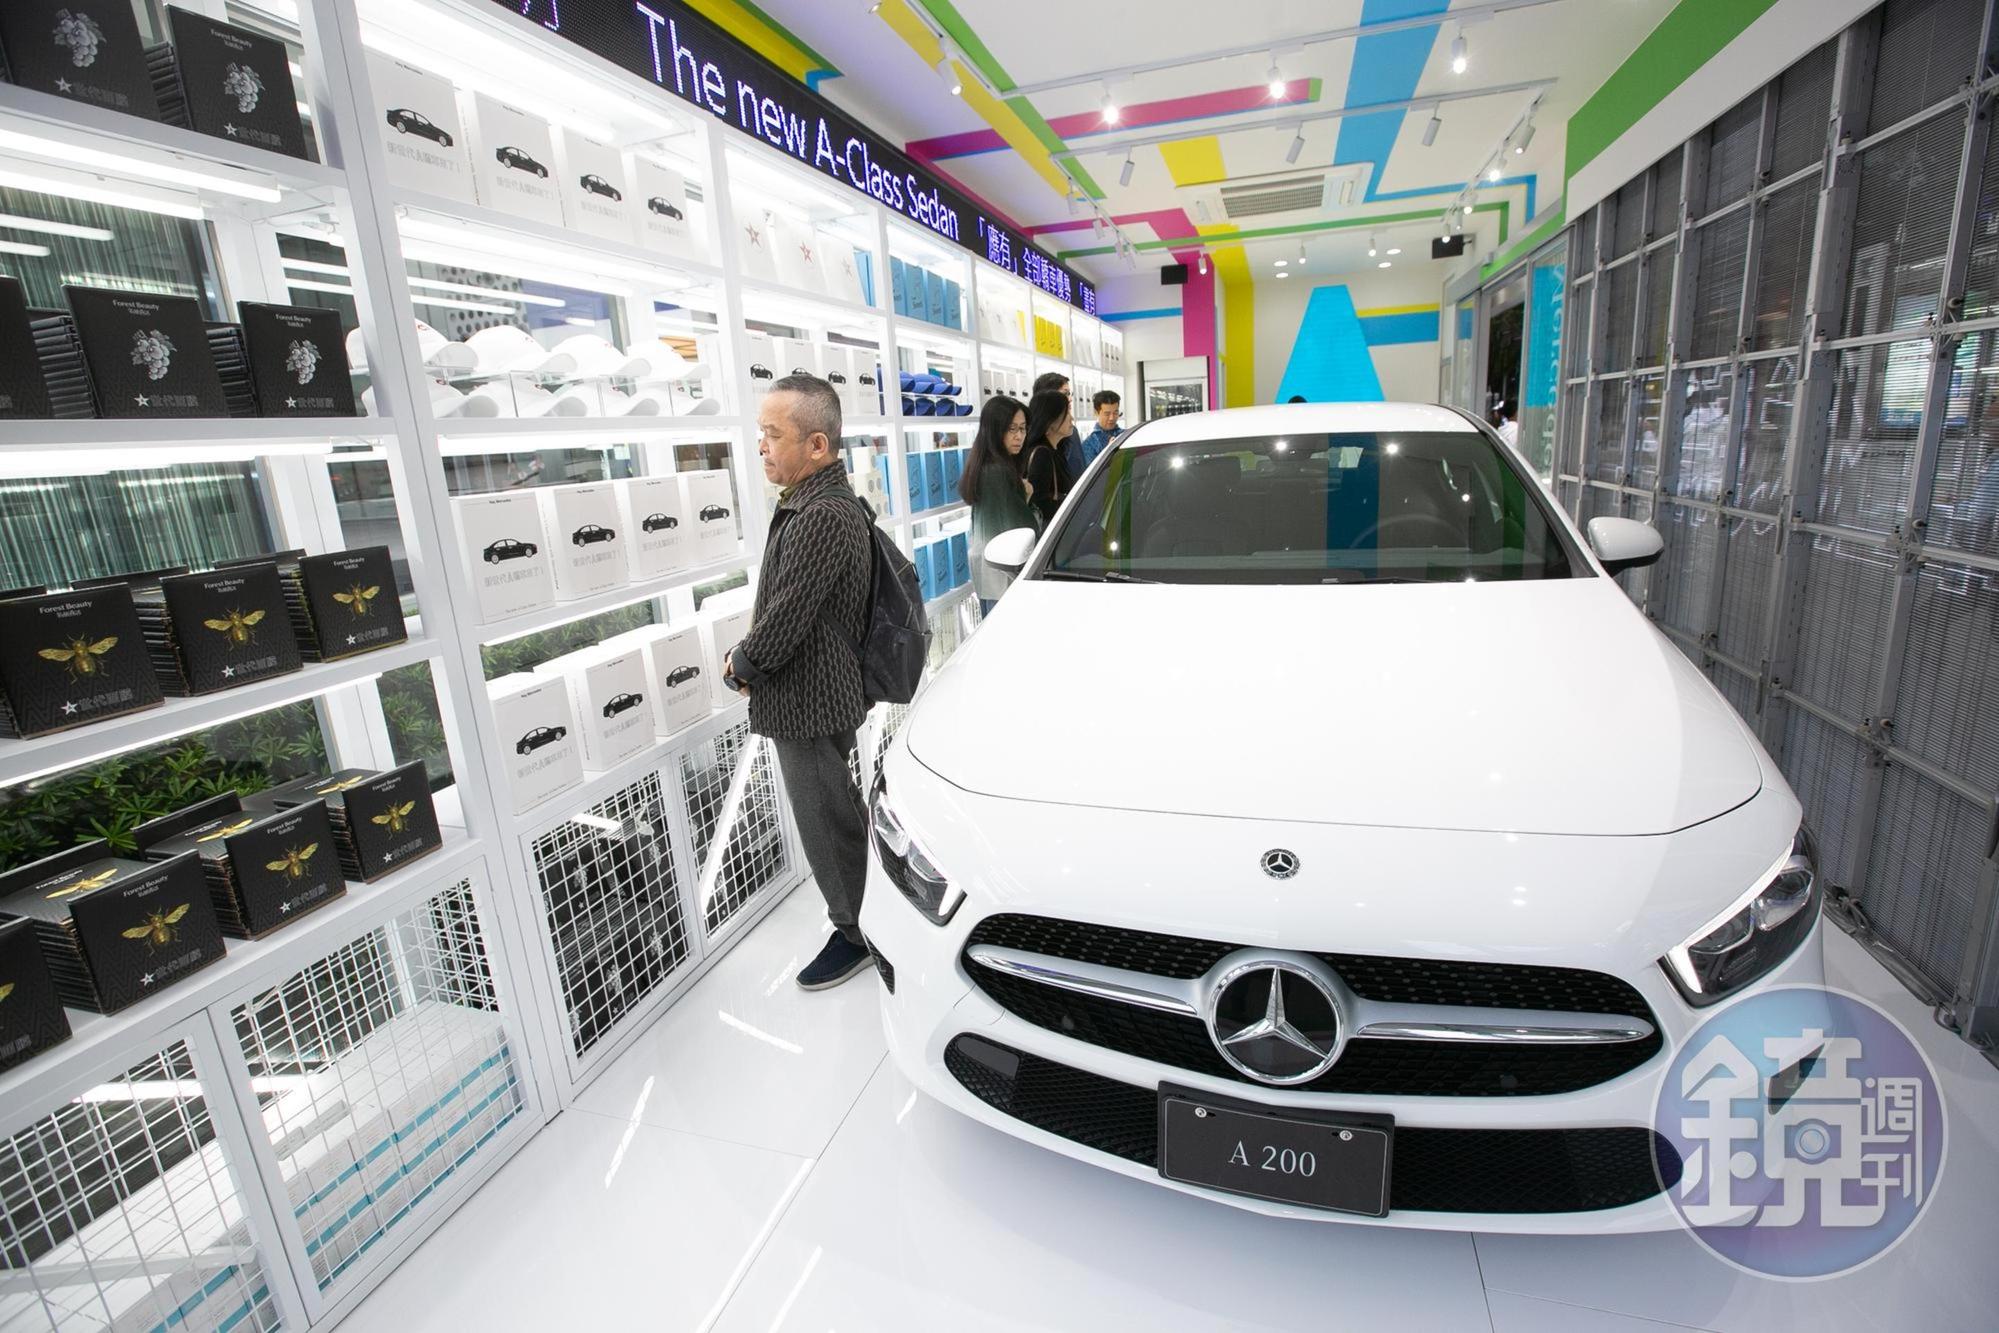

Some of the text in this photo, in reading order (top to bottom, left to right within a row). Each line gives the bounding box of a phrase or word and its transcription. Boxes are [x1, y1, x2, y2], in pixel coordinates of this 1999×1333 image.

[636, 1, 960, 241] The new A-Class Sedan
[39, 604, 65, 614] Forest
[65, 600, 93, 610] Beauty
[1227, 1140, 1316, 1177] A 200
